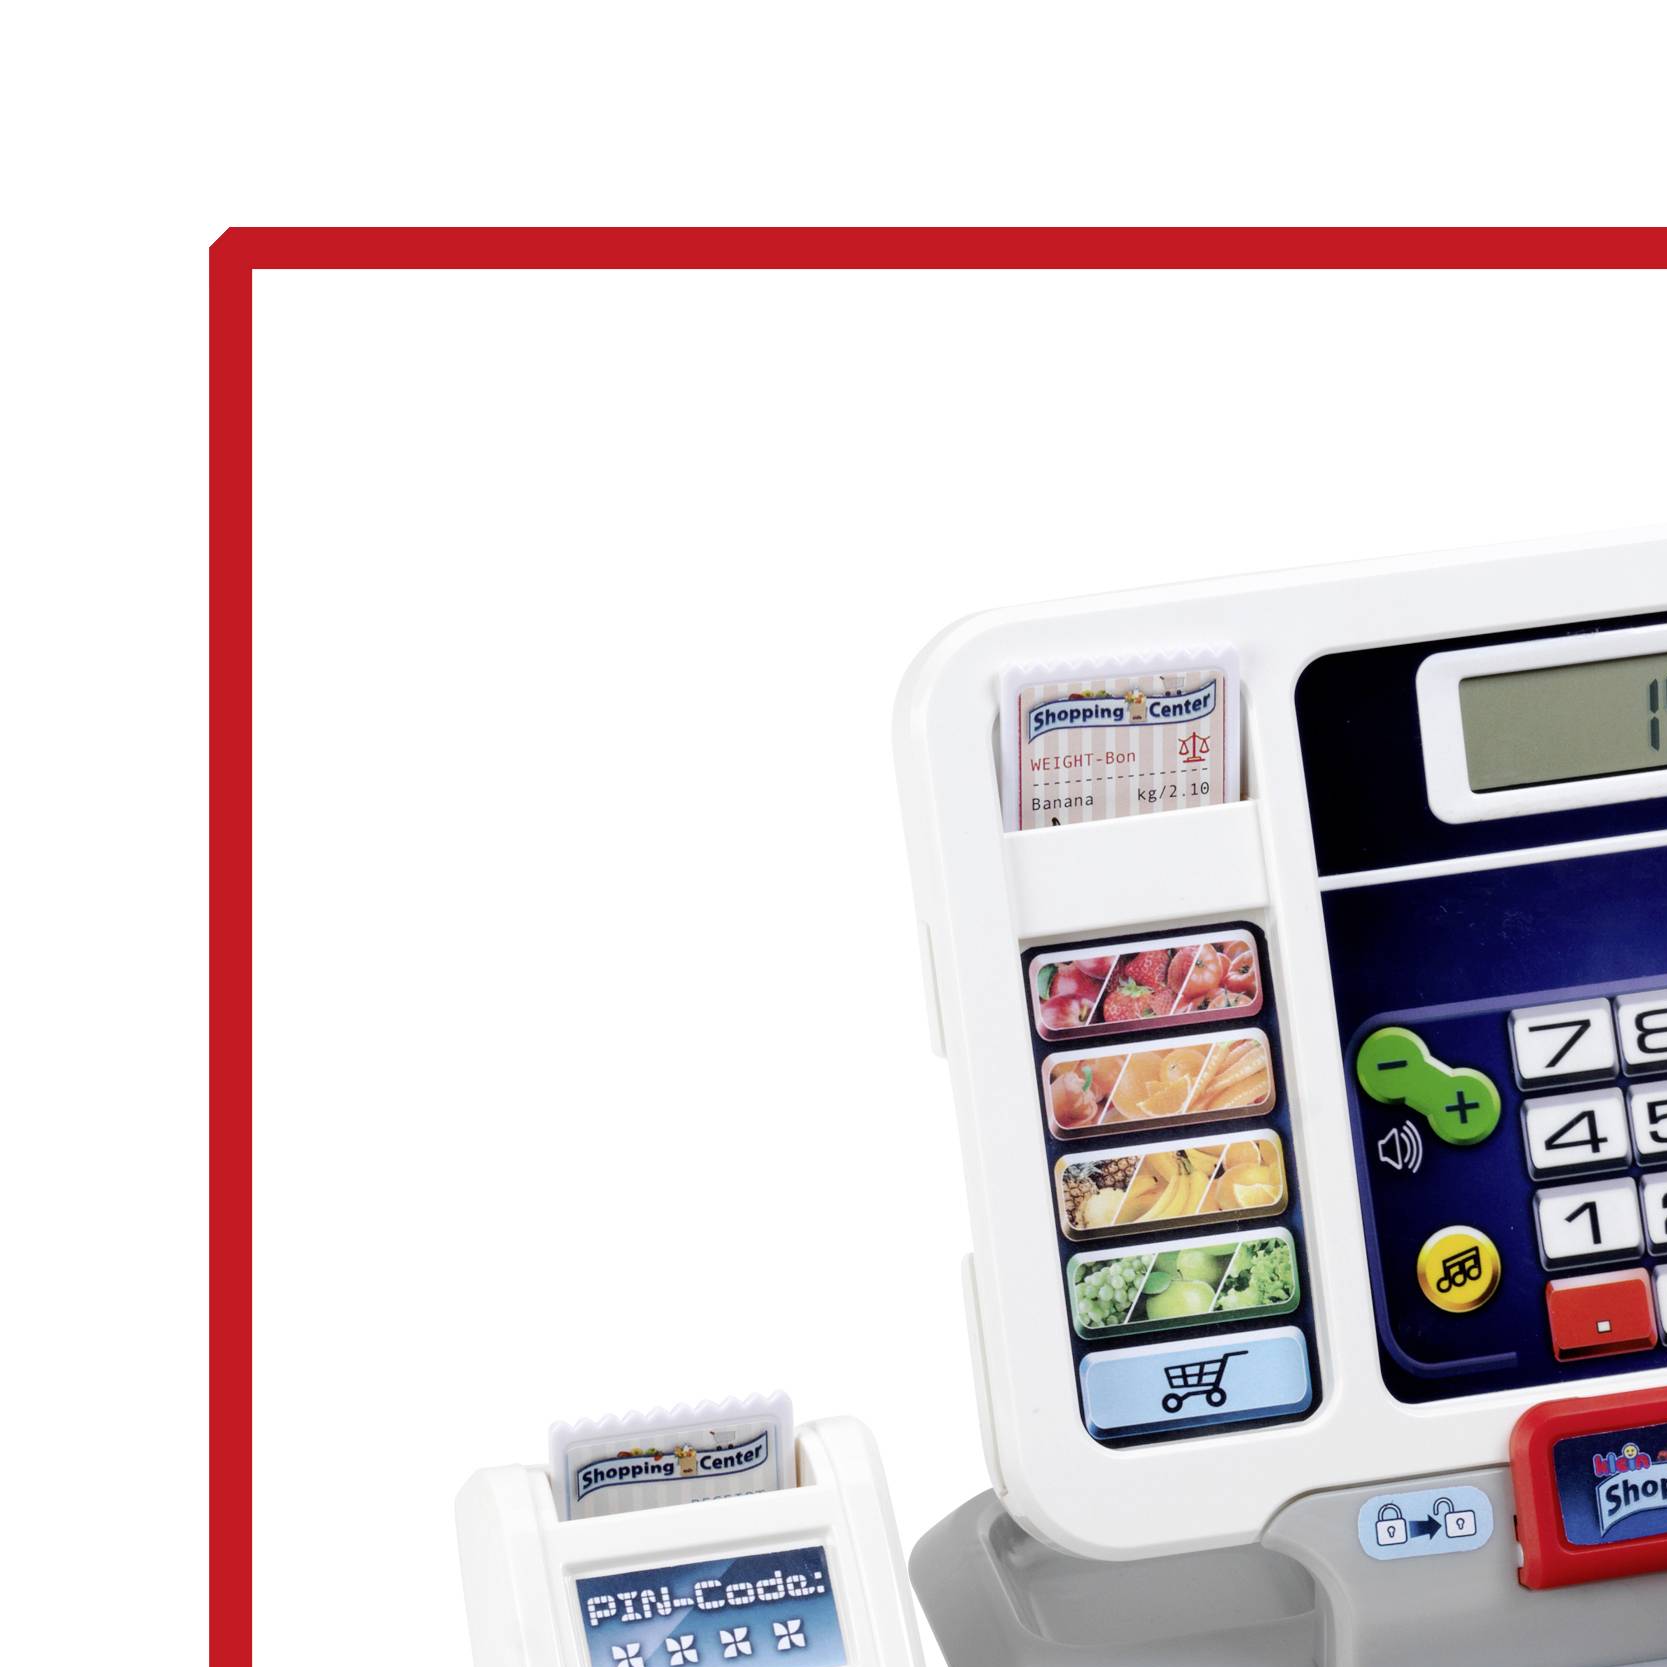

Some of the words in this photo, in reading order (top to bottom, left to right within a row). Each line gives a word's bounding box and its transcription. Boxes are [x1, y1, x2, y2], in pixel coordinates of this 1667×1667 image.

[1034, 704, 1124, 731] Shopping
[1150, 693, 1211, 718] Center
[1030, 751, 1136, 772] WEIGHT-Bon
[1032, 795, 1094, 811] Banana
[1138, 781, 1210, 803] kg/2.10
[1528, 1019, 1591, 1068] 7
[1544, 1110, 1608, 1154] 4
[1565, 1201, 1603, 1245] 1
[582, 1462, 675, 1489] Shopping
[700, 1445, 763, 1471] Center
[587, 1570, 825, 1626] PIN-Code:
